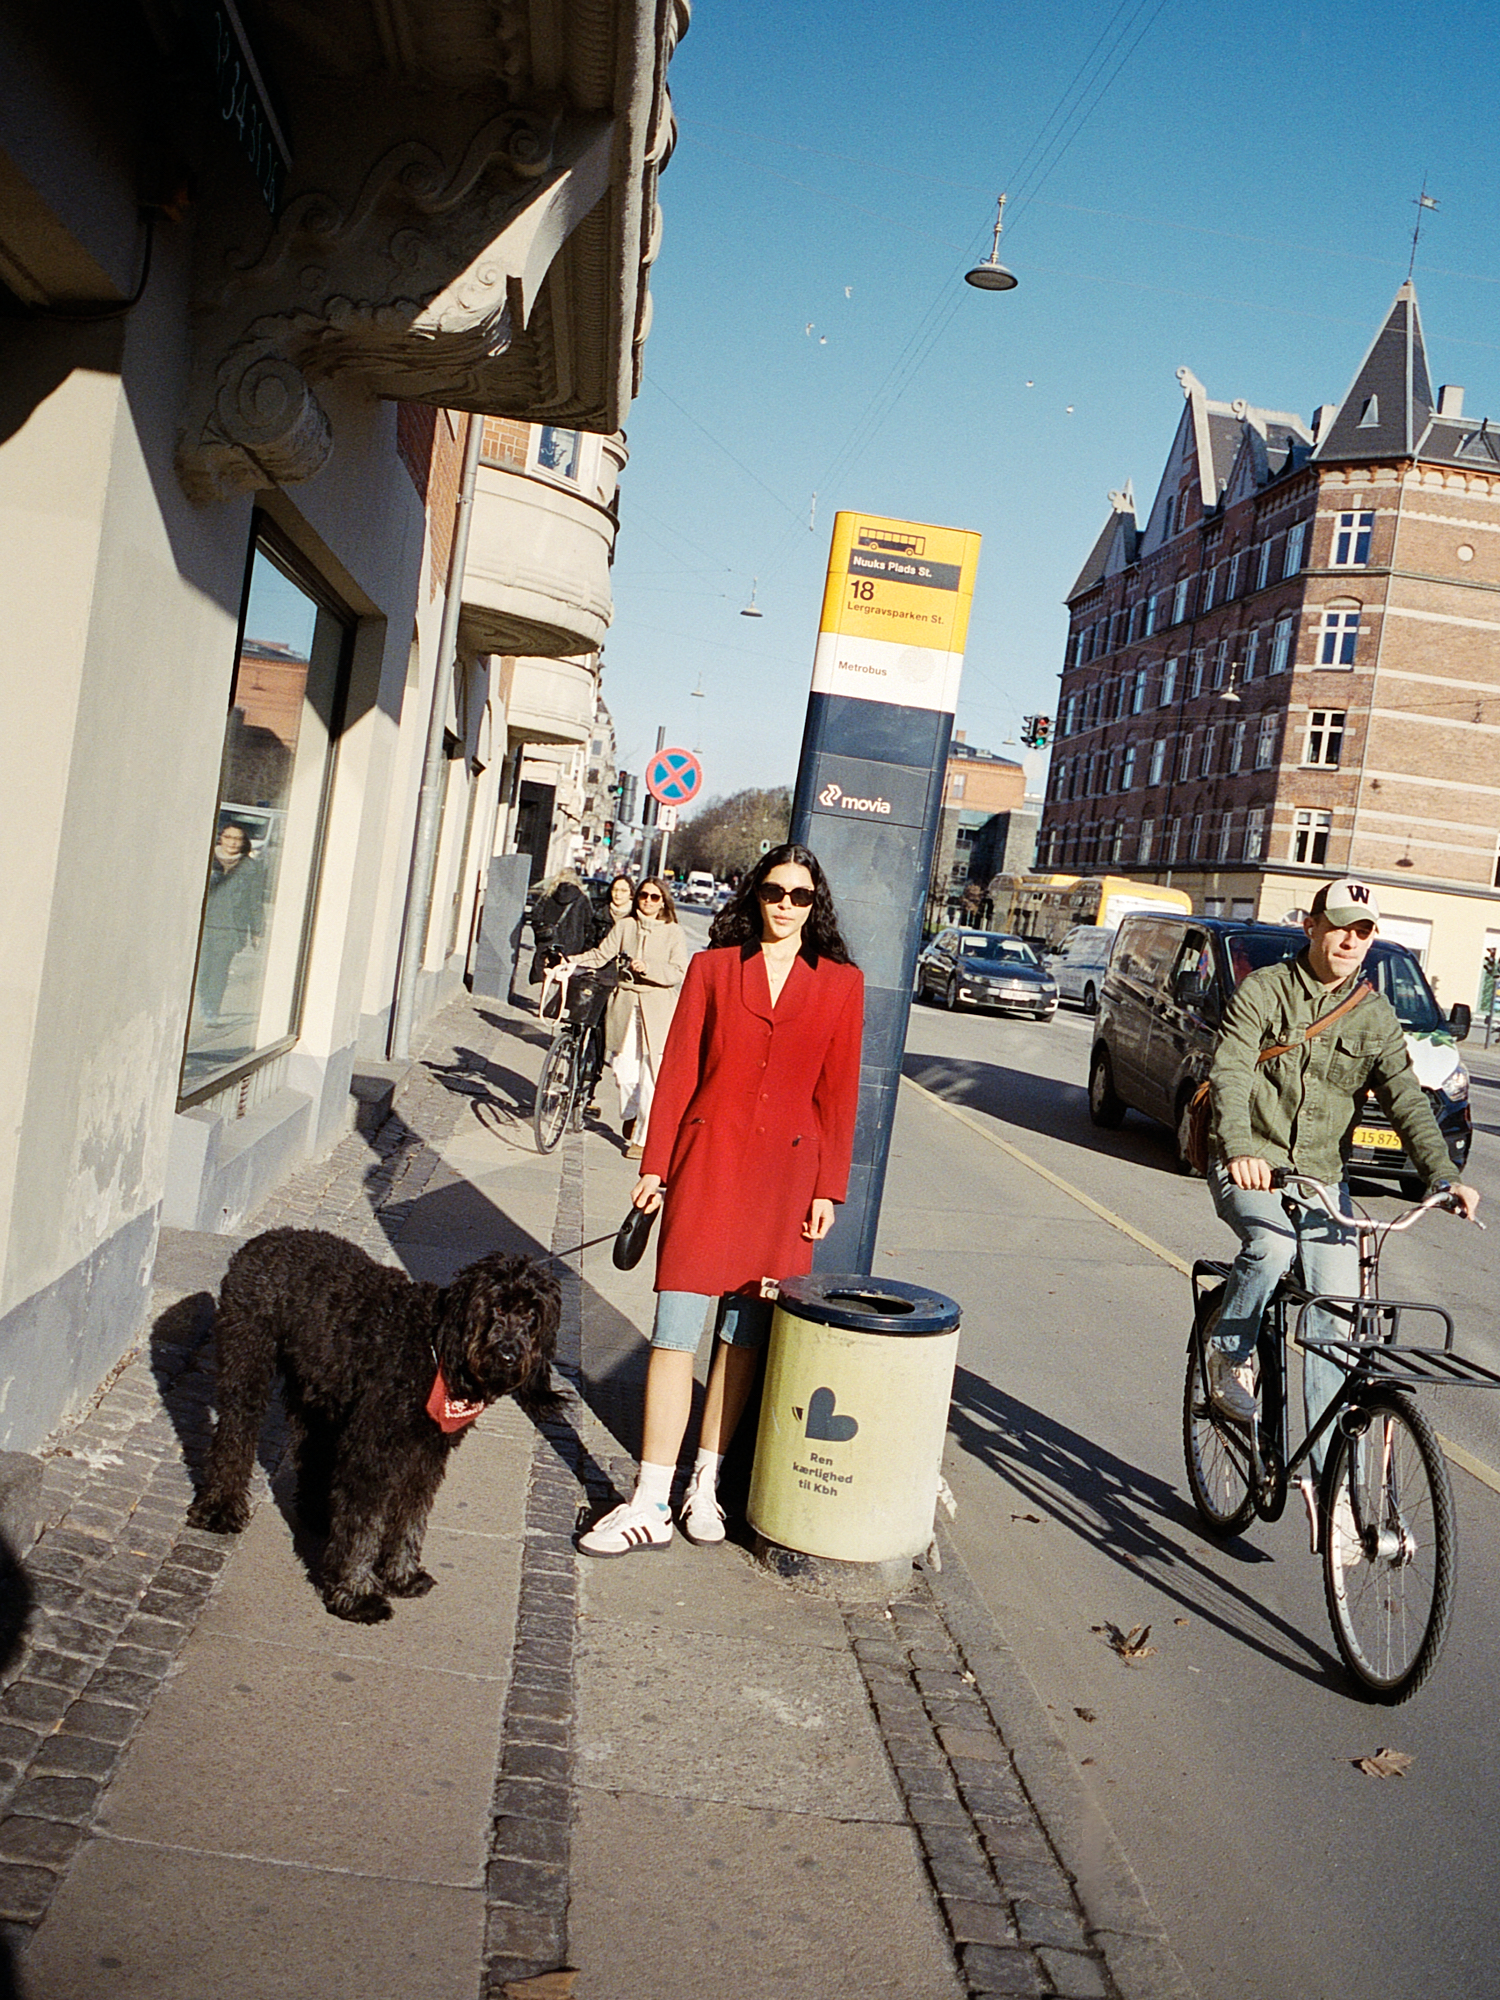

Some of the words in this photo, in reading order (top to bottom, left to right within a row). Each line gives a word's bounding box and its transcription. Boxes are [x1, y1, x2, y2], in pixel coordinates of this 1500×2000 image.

[853, 556, 886, 570] Nuuks
[887, 561, 917, 575] Plads
[918, 566, 933, 578] St.
[850, 579, 875, 601] 18
[847, 601, 928, 622] Lergravsparken
[931, 614, 945, 625] St.
[838, 660, 888, 676] Metrobus
[841, 796, 891, 815] movia
[1346, 884, 1370, 905] W
[810, 1452, 833, 1466] Ren
[792, 1461, 853, 1484] kærlighed
[798, 1479, 811, 1490] til
[813, 1483, 838, 1496] Kbh
